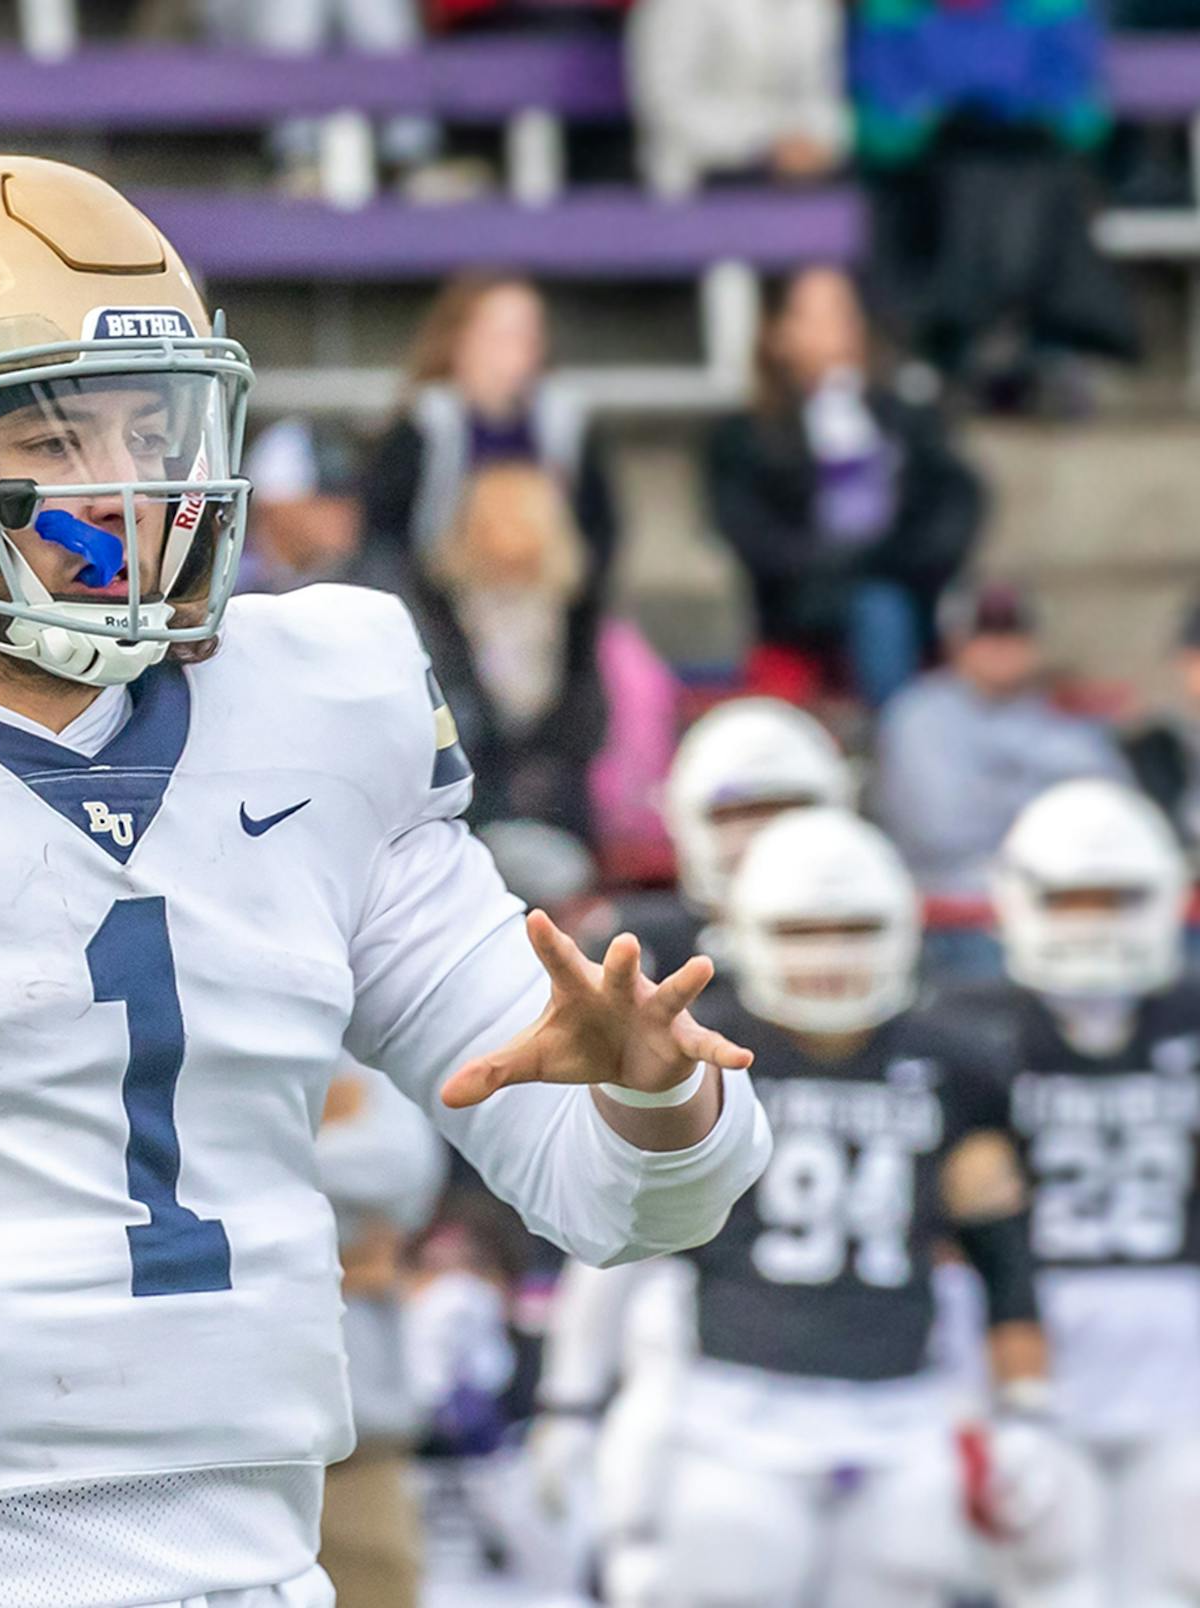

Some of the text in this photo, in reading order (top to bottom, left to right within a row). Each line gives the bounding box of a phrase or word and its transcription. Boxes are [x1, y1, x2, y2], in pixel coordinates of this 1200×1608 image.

[106, 315, 187, 337] BETHEL
[82, 801, 134, 847] BU
[85, 896, 233, 1297] 1
[752, 1131, 914, 1287] 94
